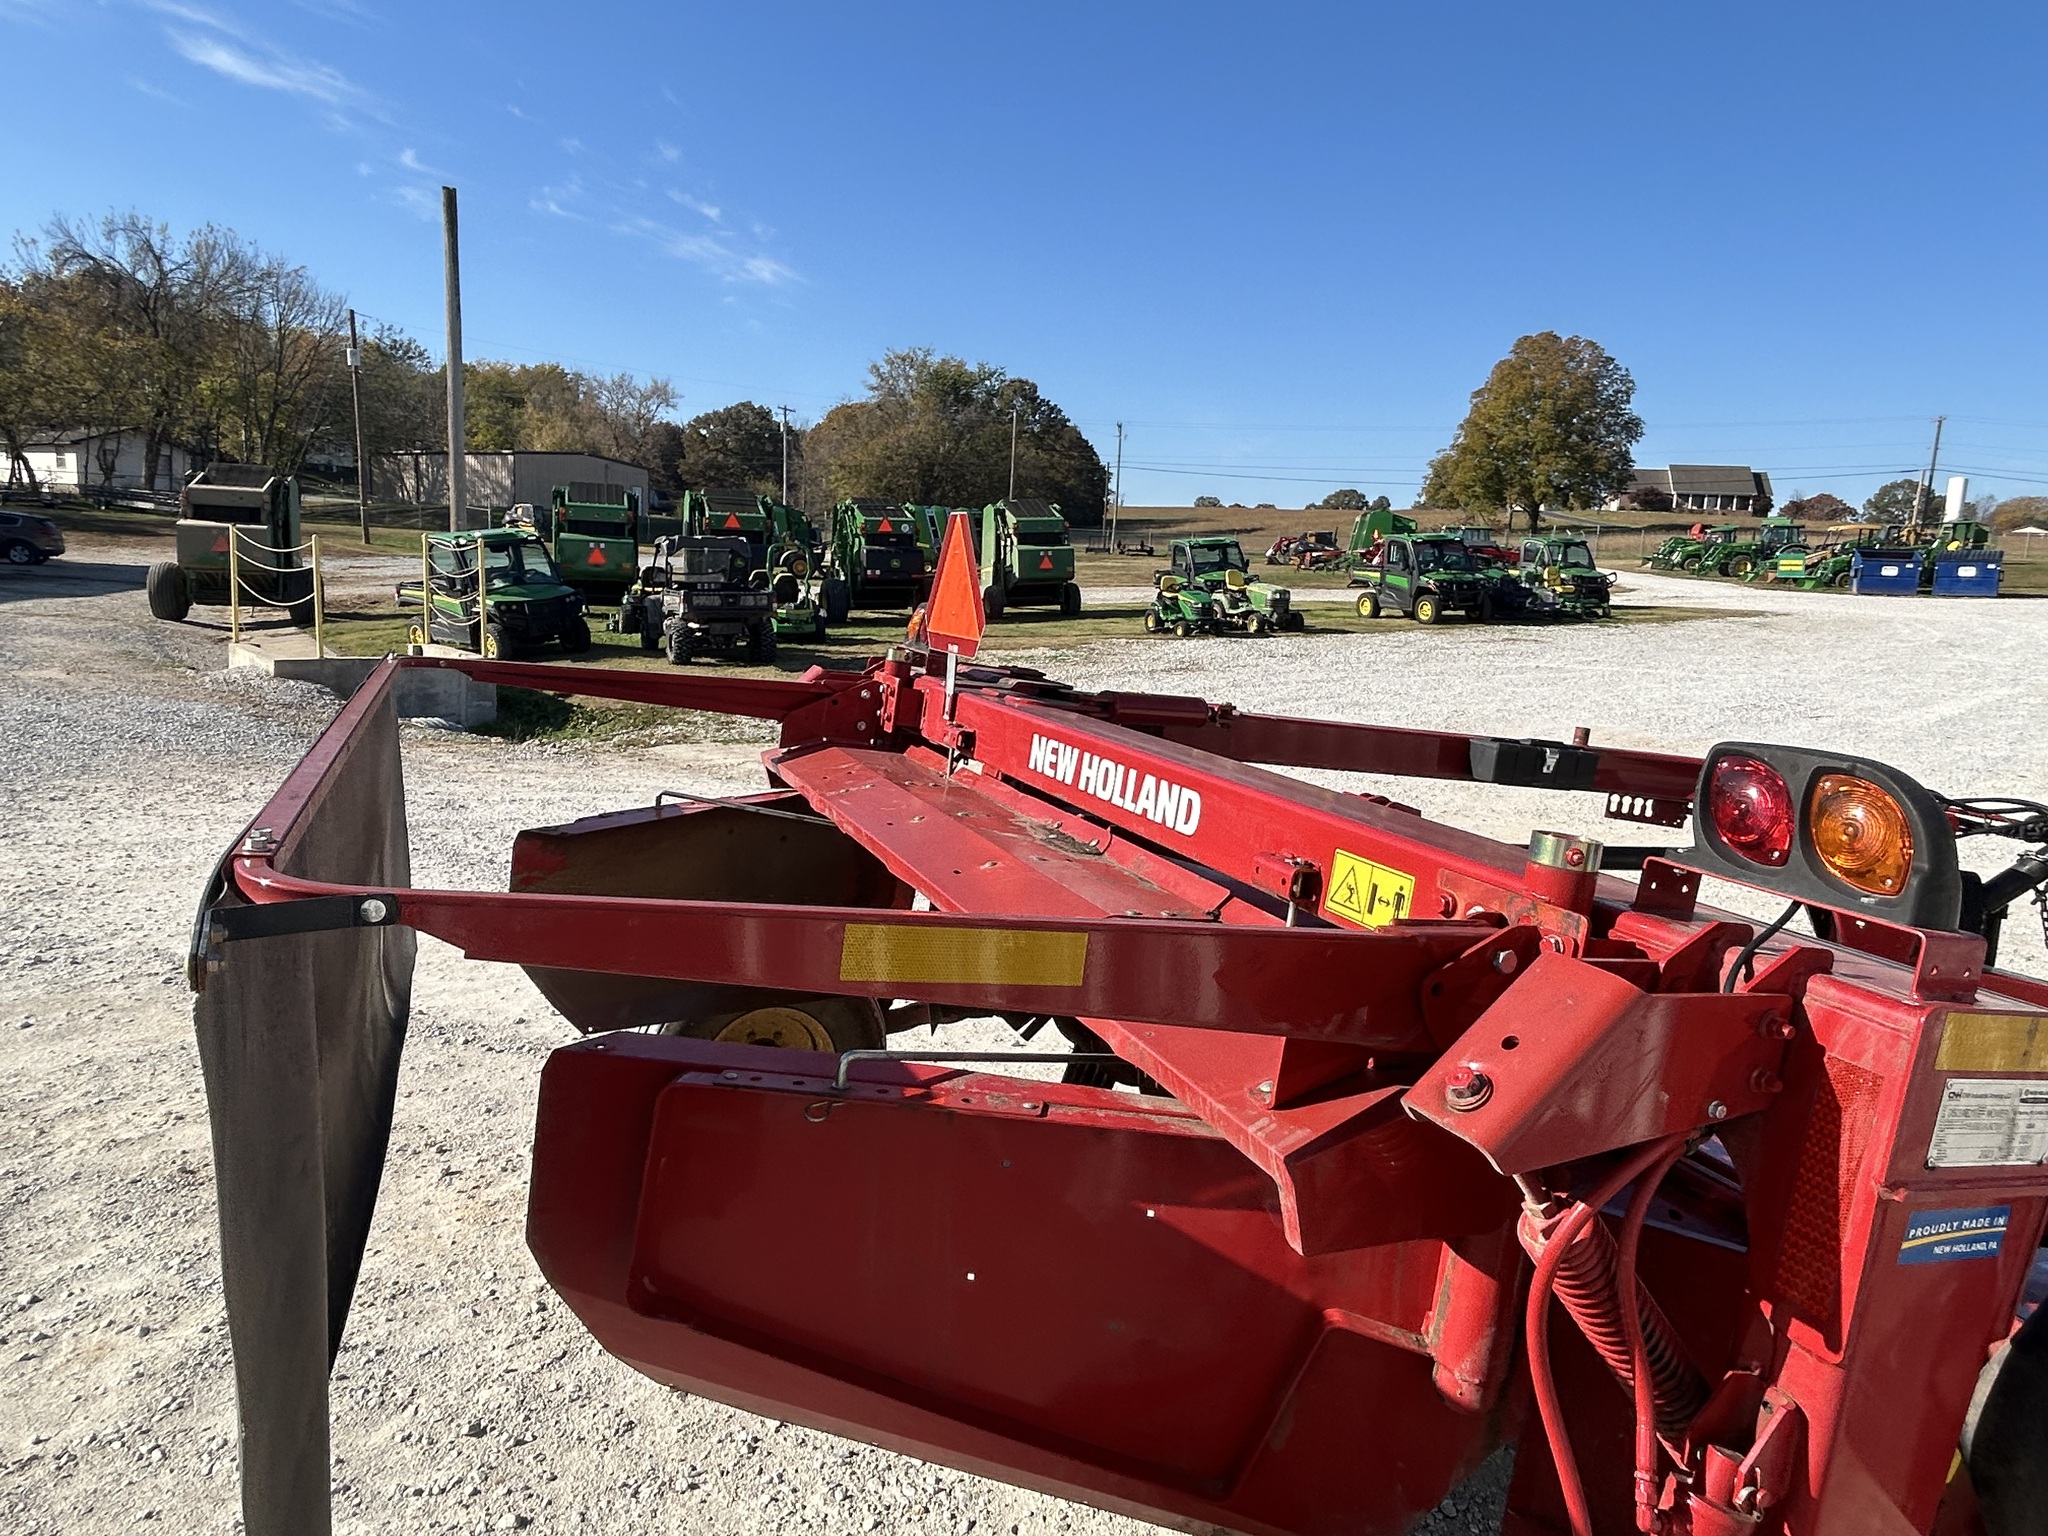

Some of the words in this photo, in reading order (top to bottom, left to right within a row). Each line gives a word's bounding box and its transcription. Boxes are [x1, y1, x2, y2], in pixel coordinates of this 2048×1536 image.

[1028, 733, 1080, 785] NEW
[1078, 751, 1201, 837] HOLLAND
[1908, 1221, 1959, 1239] PROUDLY
[1961, 1217, 1991, 1230] MADE
[1993, 1216, 2006, 1226] IN
[1932, 1245, 1952, 1255] NEW
